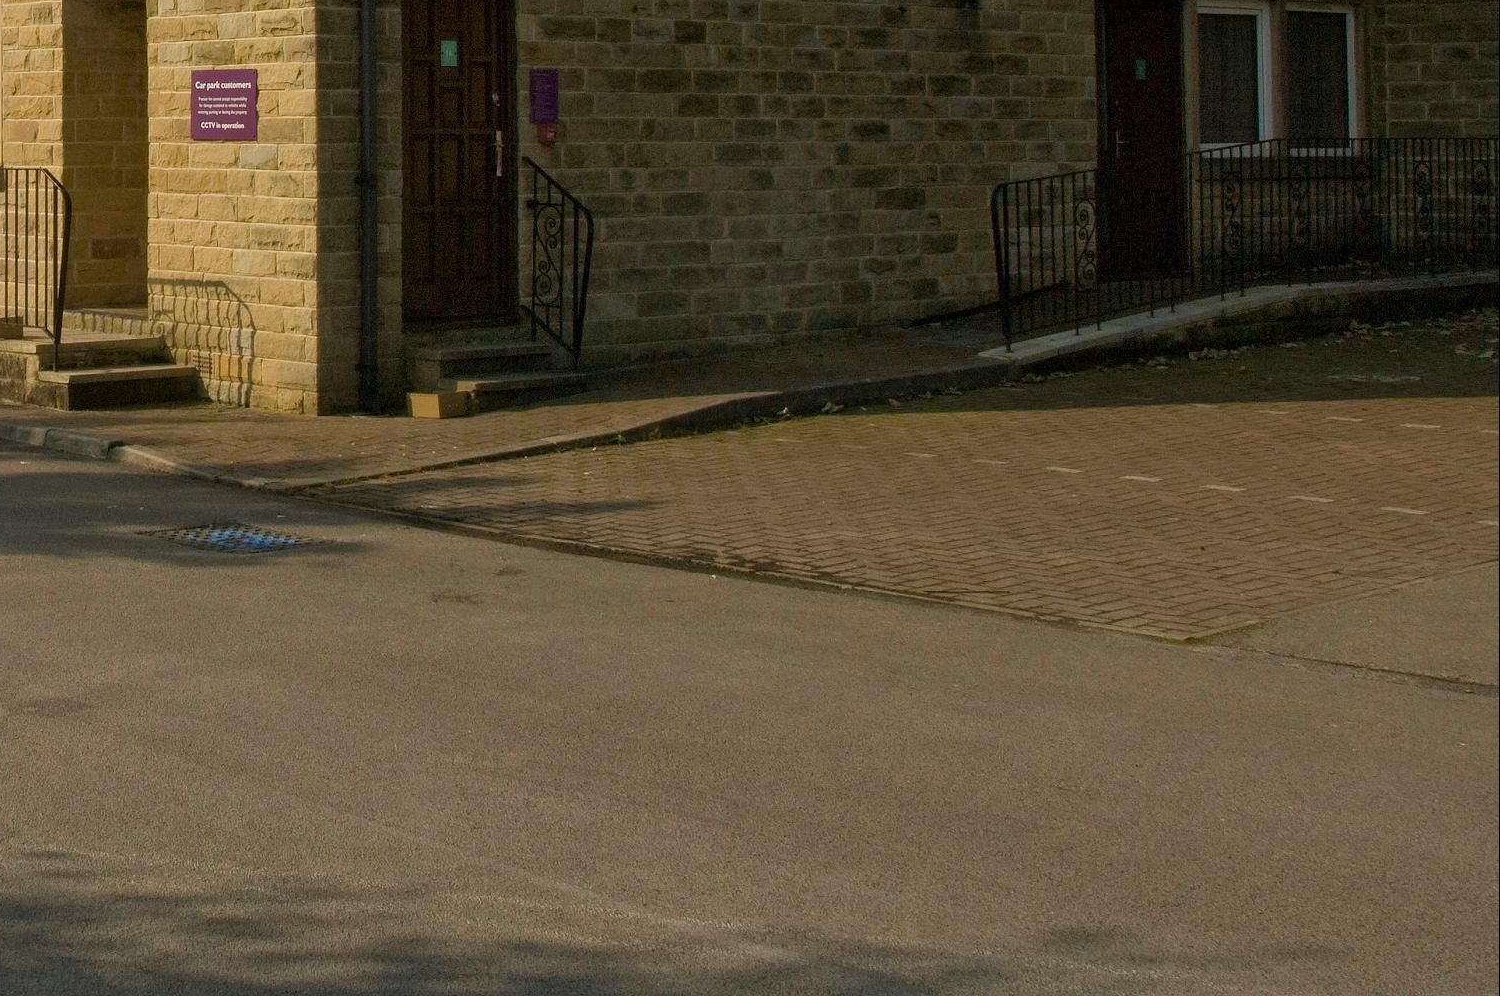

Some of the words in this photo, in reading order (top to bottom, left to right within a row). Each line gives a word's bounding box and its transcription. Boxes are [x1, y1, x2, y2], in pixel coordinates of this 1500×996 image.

[195, 81, 206, 89] Car
[206, 81, 220, 91] park
[200, 121, 215, 129] CCTV
[221, 121, 245, 130] operation
